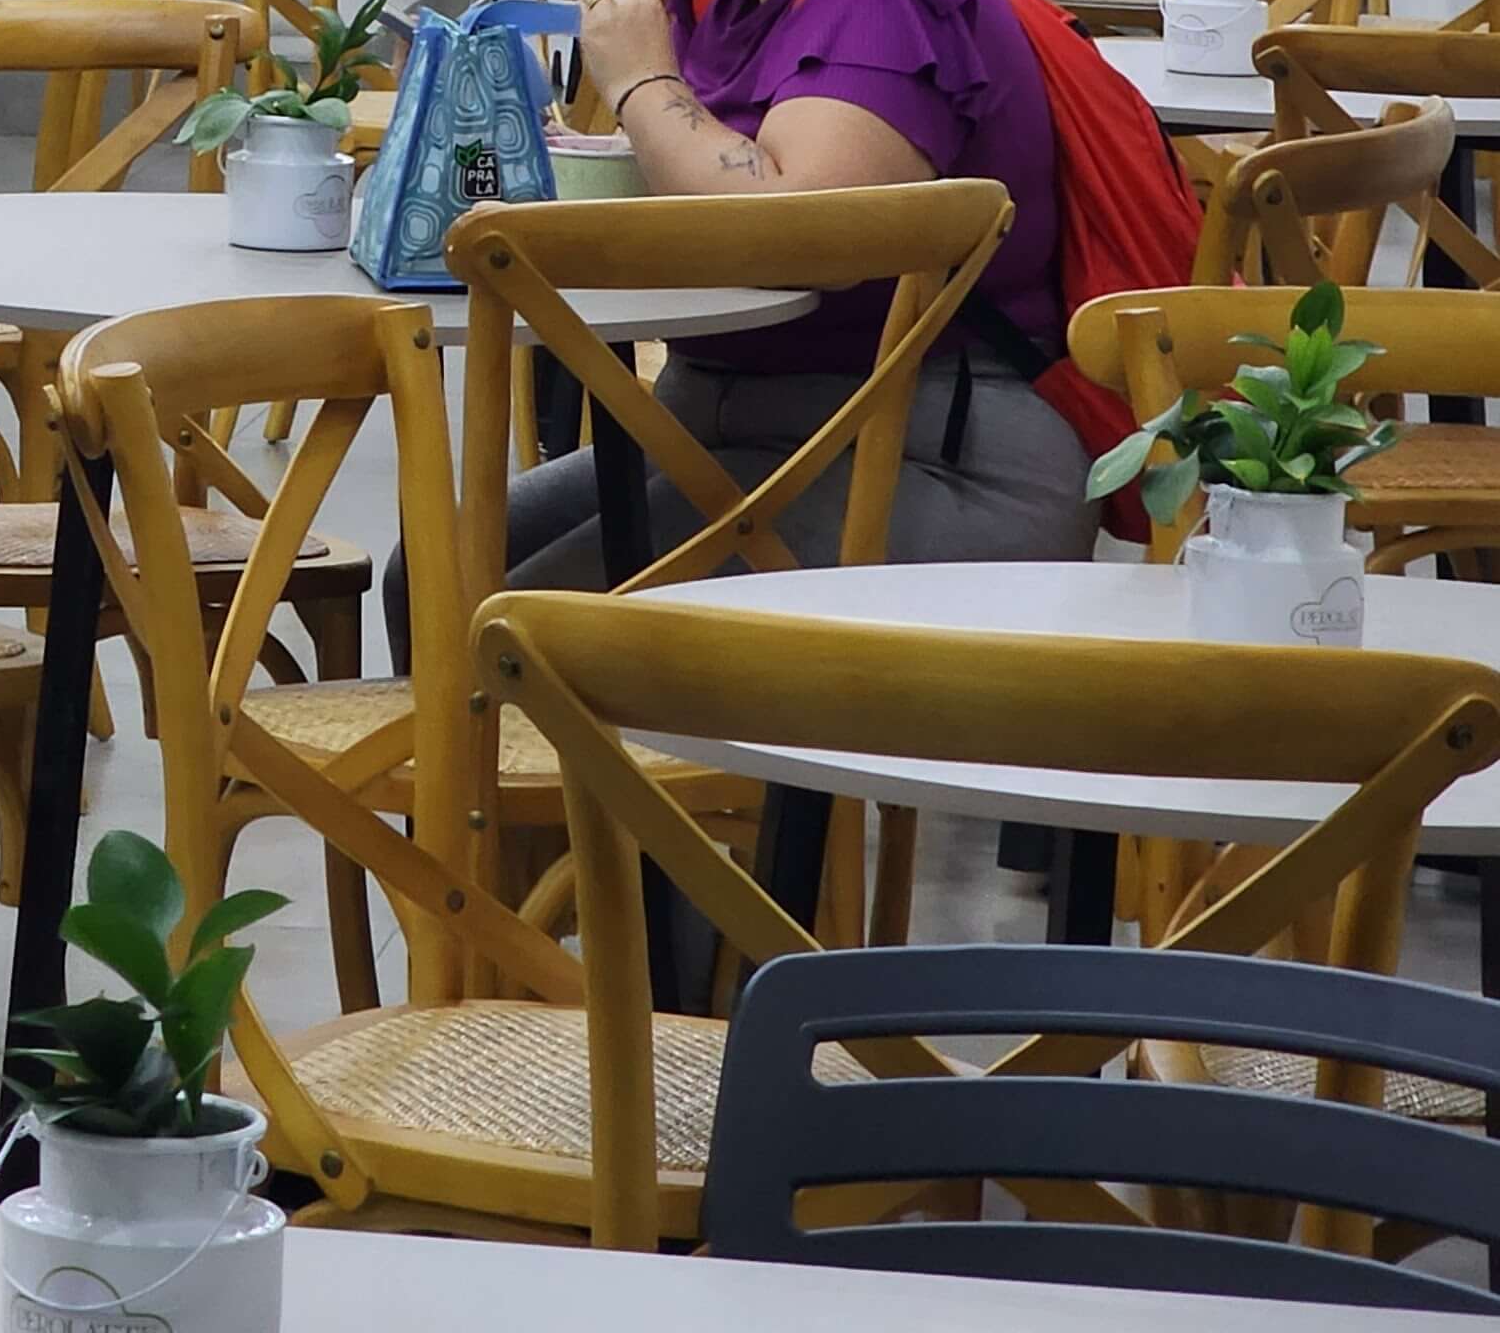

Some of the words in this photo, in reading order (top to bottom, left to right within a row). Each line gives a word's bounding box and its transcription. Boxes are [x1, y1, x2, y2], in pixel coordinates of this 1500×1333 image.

[476, 155, 495, 169] CA
[467, 169, 495, 182] PRA
[475, 182, 494, 195] LA
